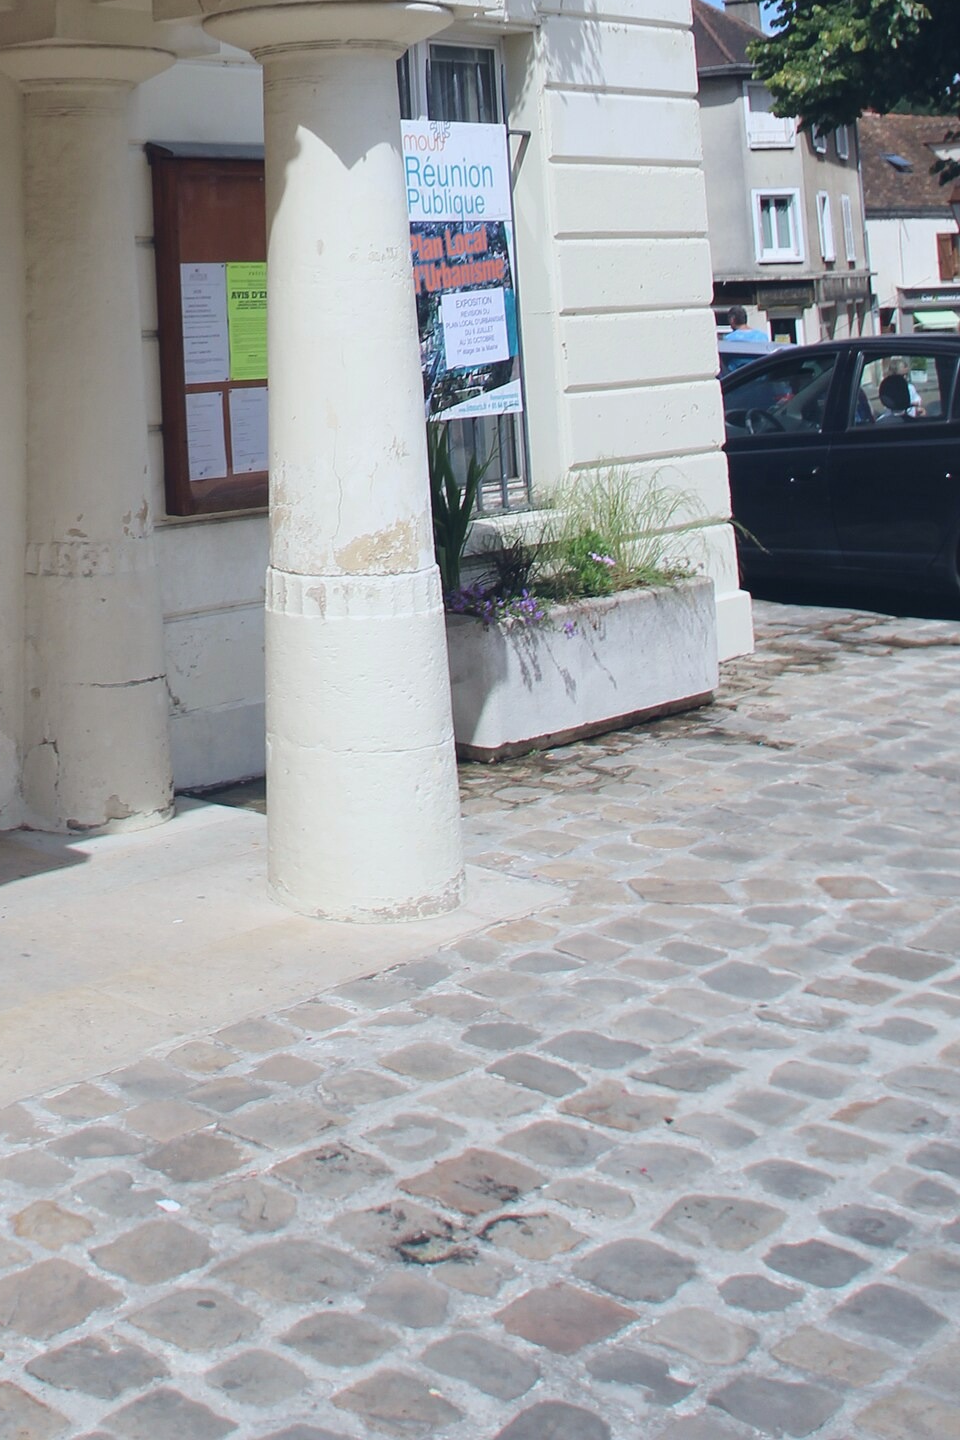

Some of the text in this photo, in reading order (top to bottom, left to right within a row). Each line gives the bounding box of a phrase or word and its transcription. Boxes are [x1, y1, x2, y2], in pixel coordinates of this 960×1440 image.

[405, 155, 494, 188] Réunion
[407, 188, 486, 221] Publique
[445, 223, 488, 257] Local
[231, 291, 250, 300] AVIS
[455, 296, 492, 309] EXPOSITION
